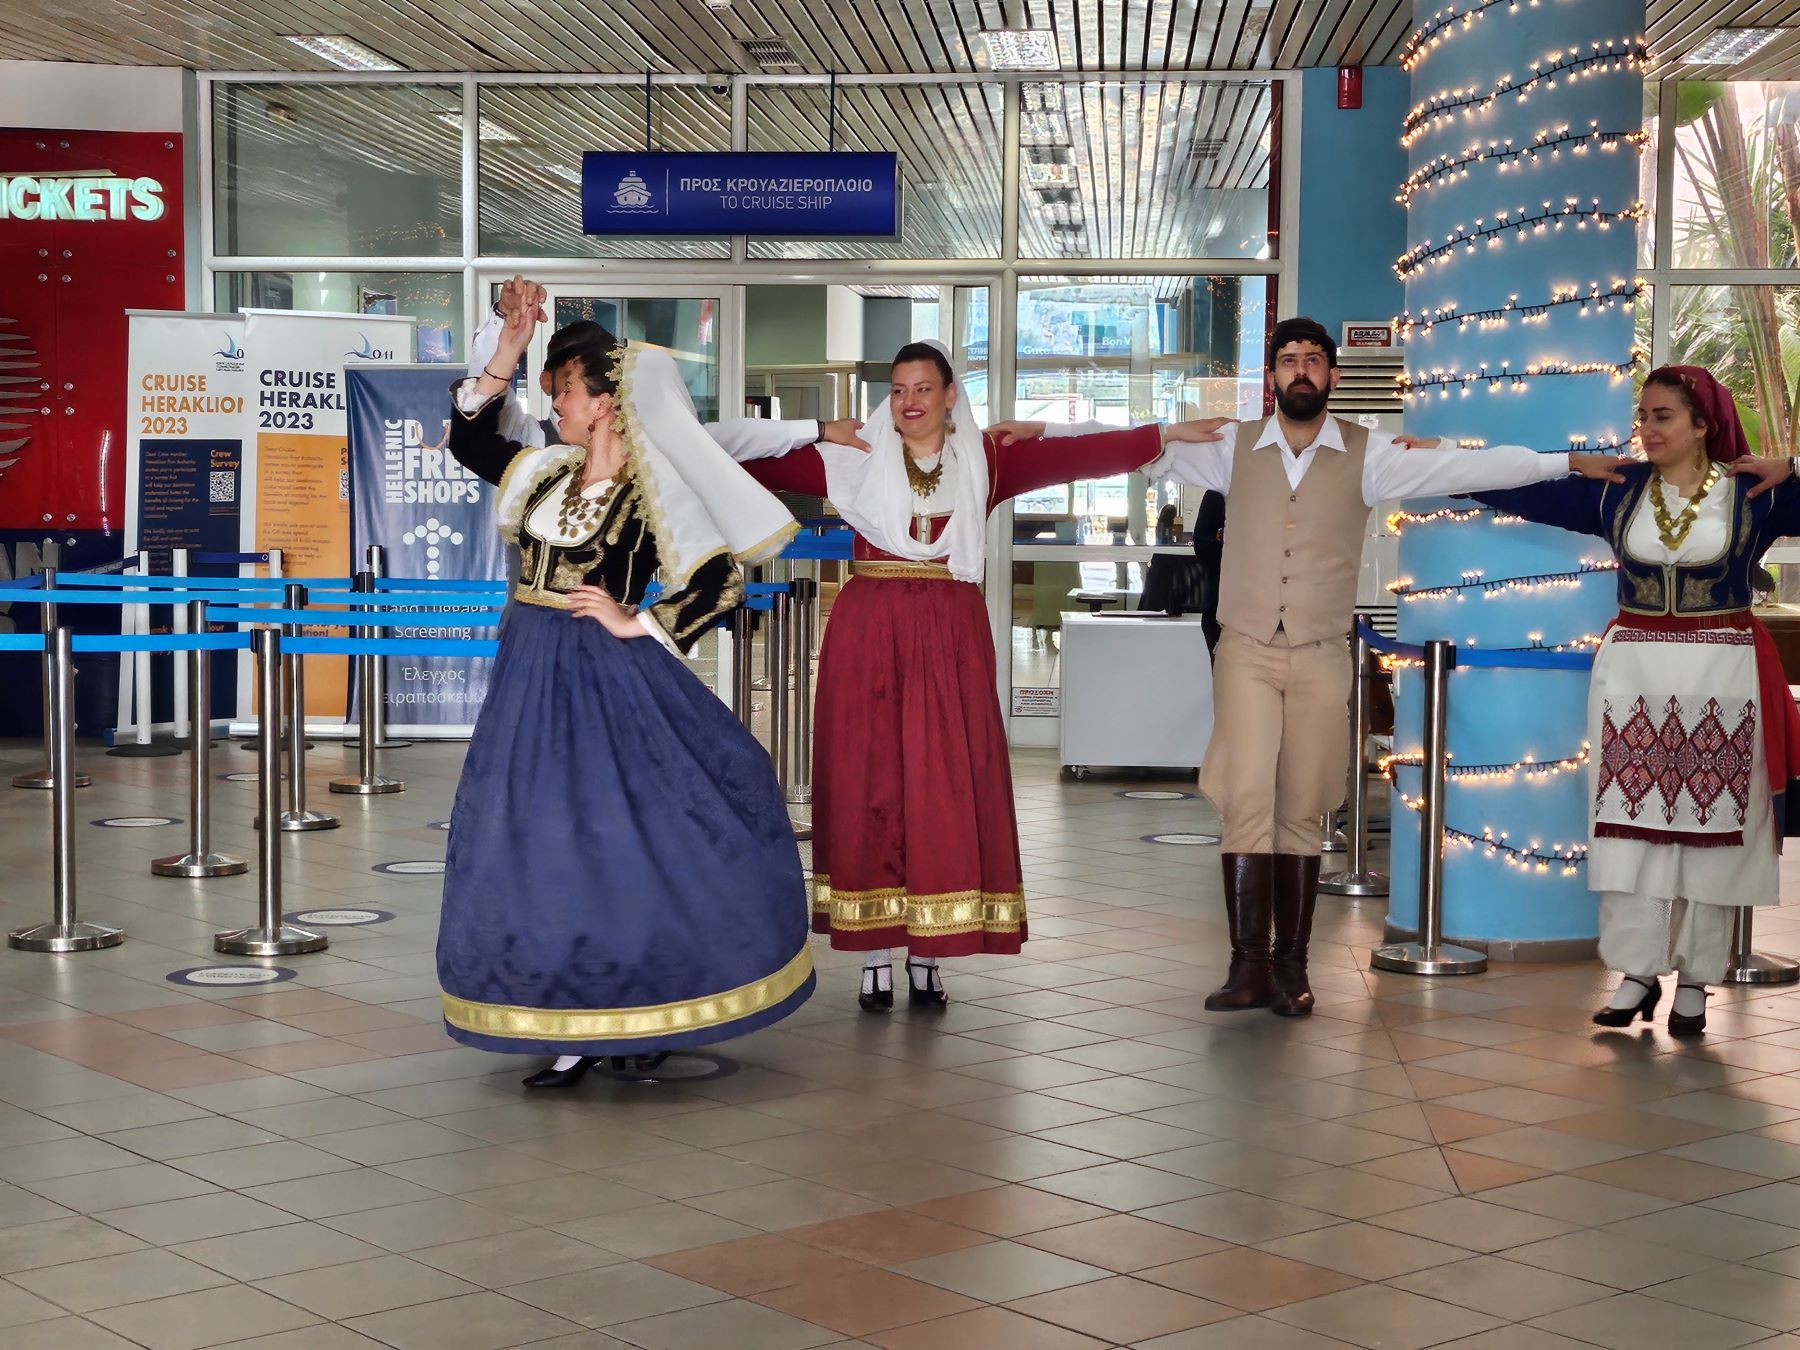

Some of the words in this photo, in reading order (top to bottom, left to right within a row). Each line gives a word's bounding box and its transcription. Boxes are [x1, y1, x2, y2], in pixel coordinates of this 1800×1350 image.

[680, 178, 721, 192] ΠΡΟΣ
[726, 178, 873, 192] ΚΡΟΥΑΖΙΕΡΟΠΛΟΙΟ
[719, 195, 738, 209] TO
[742, 195, 794, 209] CRUISE
[798, 195, 833, 209] SHIP
[141, 374, 207, 392] CRUISE
[259, 369, 336, 389] CRUISE
[141, 416, 188, 435] 2023
[259, 410, 314, 430] 2023
[210, 449, 232, 458] Crew
[384, 419, 403, 504] HELLENIC
[210, 459, 240, 470] Survey
[404, 480, 480, 504] SHOPS
[395, 626, 472, 641] Screening
[401, 666, 466, 685] Έλεγχος
